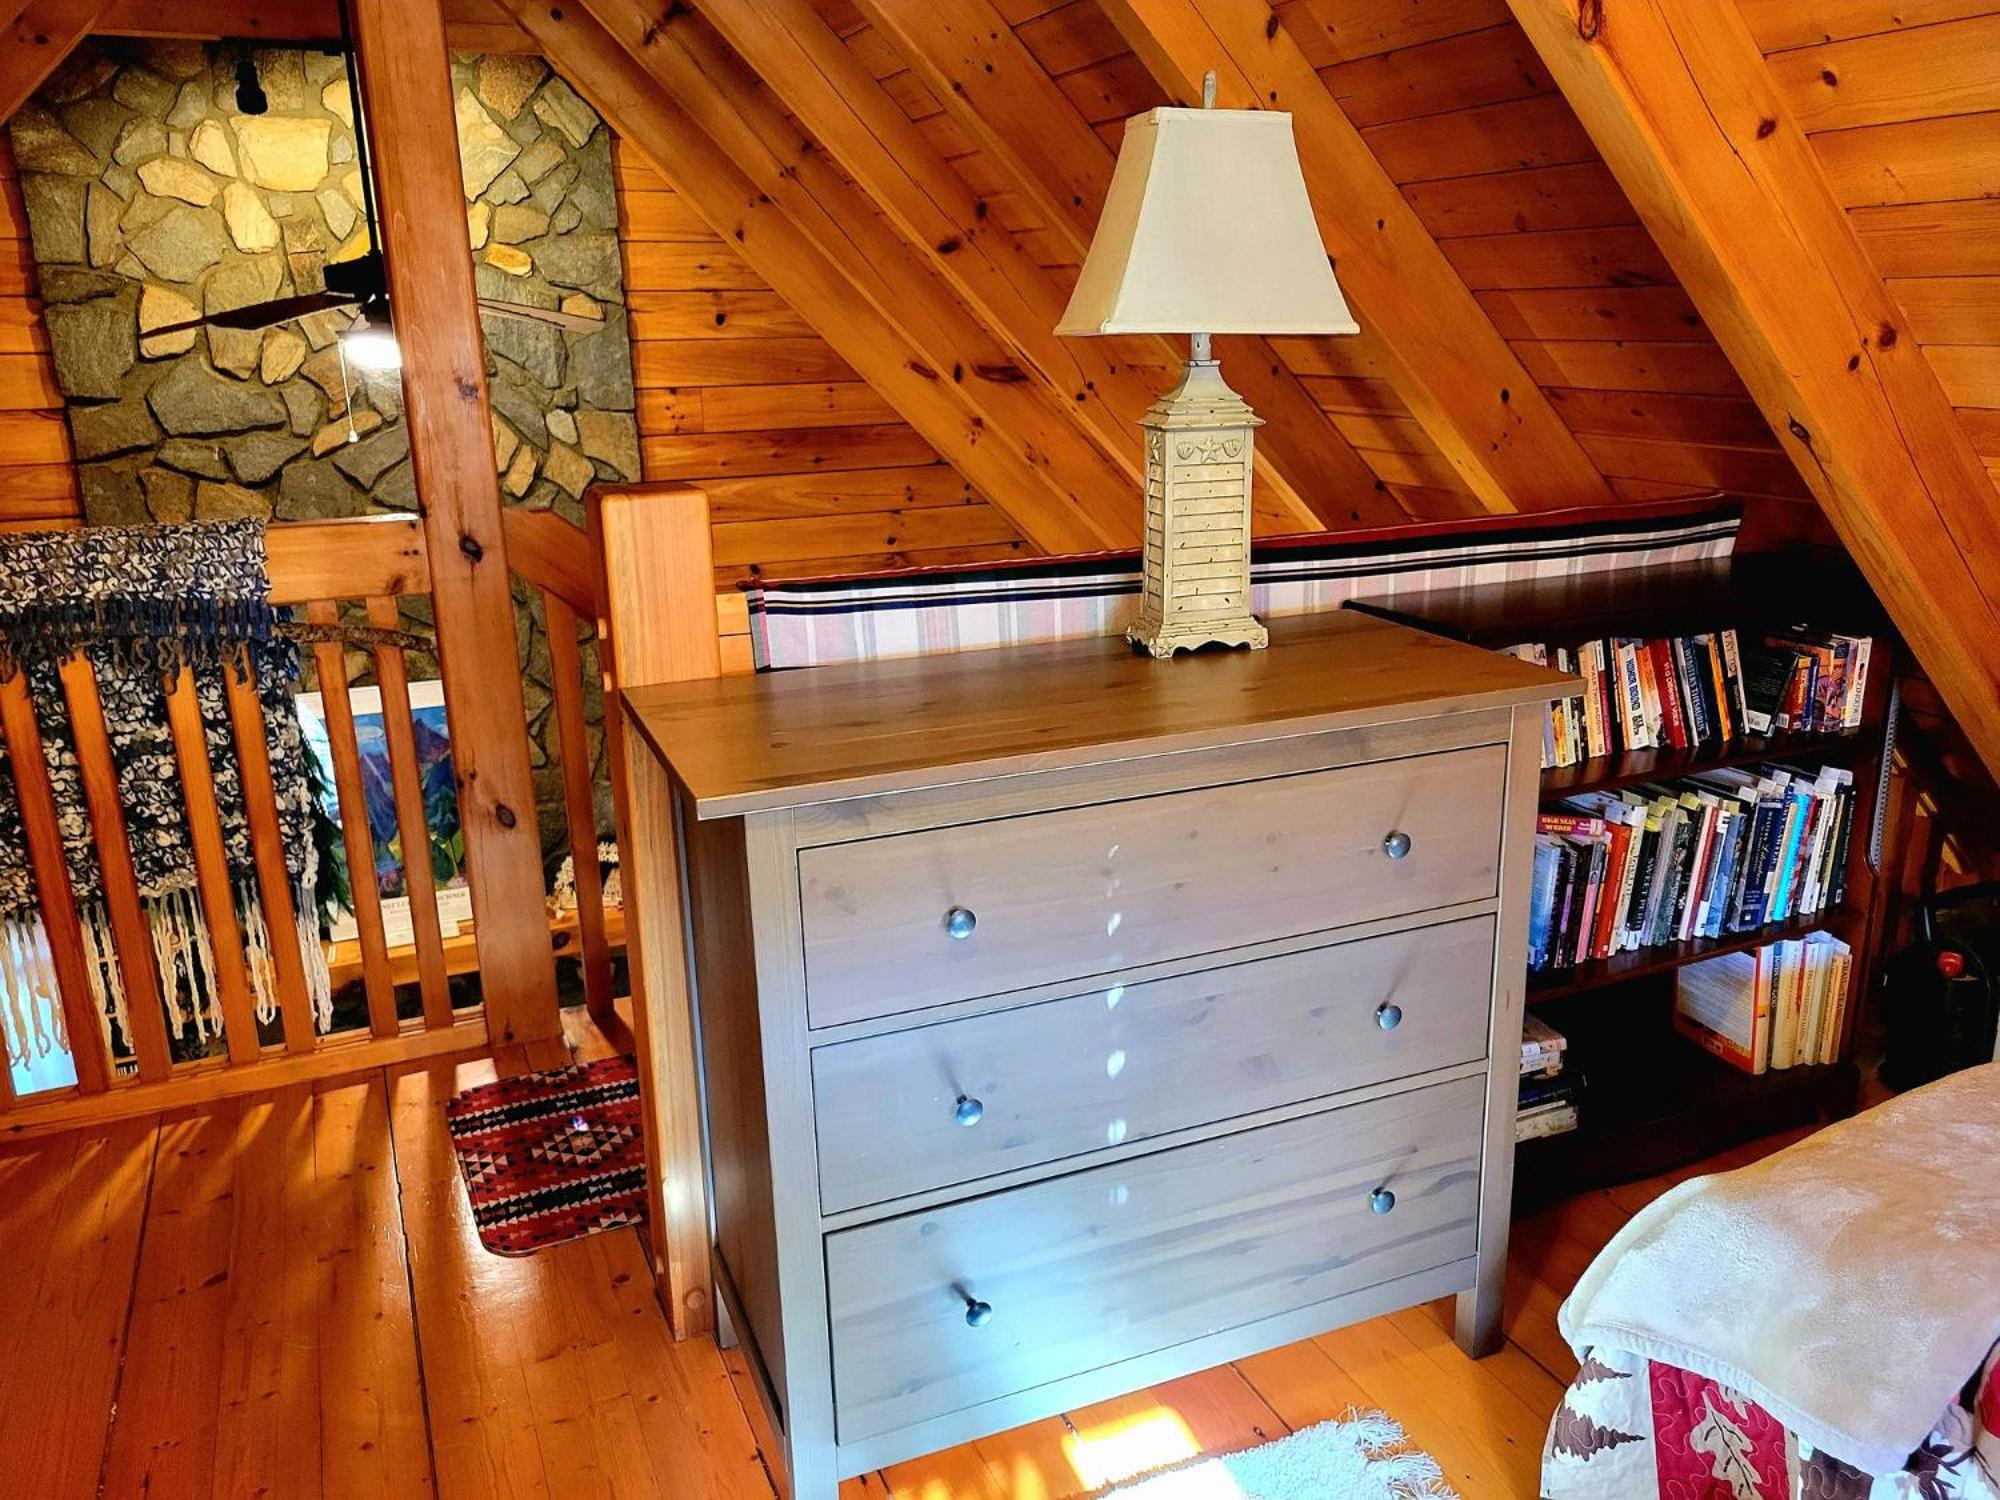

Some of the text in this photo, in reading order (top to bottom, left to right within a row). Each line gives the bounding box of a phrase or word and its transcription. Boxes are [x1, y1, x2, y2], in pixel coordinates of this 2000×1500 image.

[1672, 704, 1680, 727] Voice
[1691, 688, 1705, 731] THESAURUS
[1642, 858, 1654, 894] SWEET
